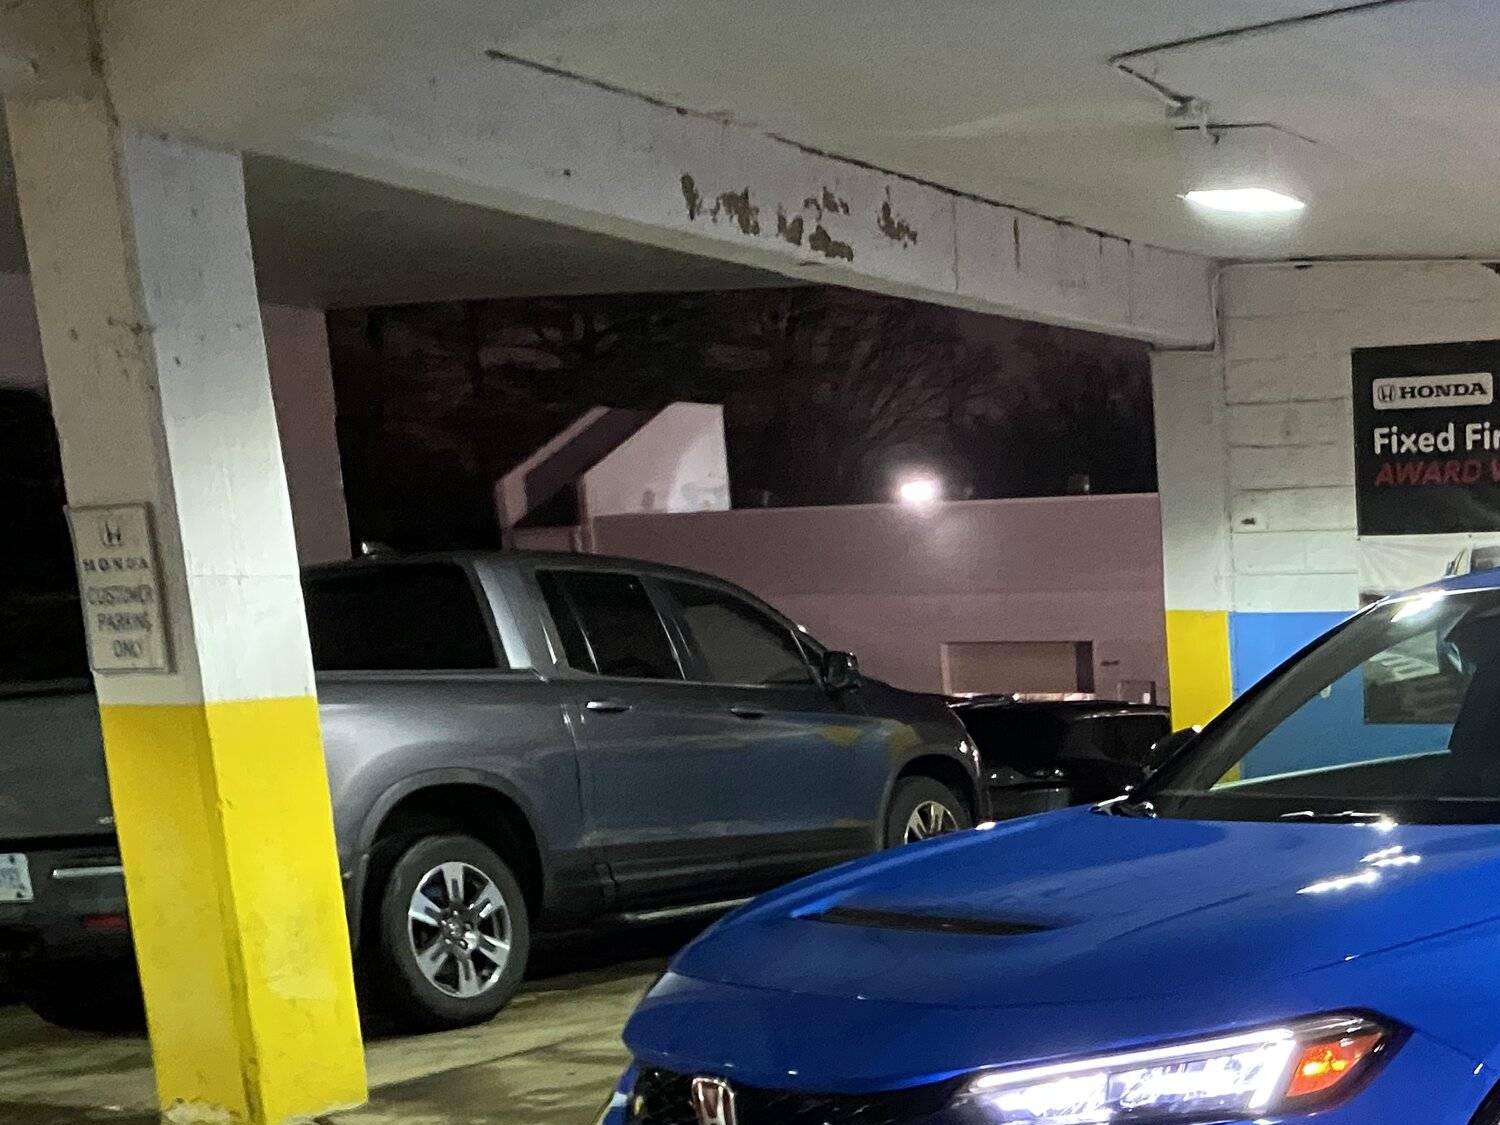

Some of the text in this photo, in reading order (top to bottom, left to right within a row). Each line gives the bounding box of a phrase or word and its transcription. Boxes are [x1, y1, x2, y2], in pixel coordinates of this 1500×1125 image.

[1398, 382, 1487, 399] HONDA
[1373, 422, 1455, 454] Fixed
[1375, 459, 1481, 487] AWARD
[82, 558, 149, 571] HONDA
